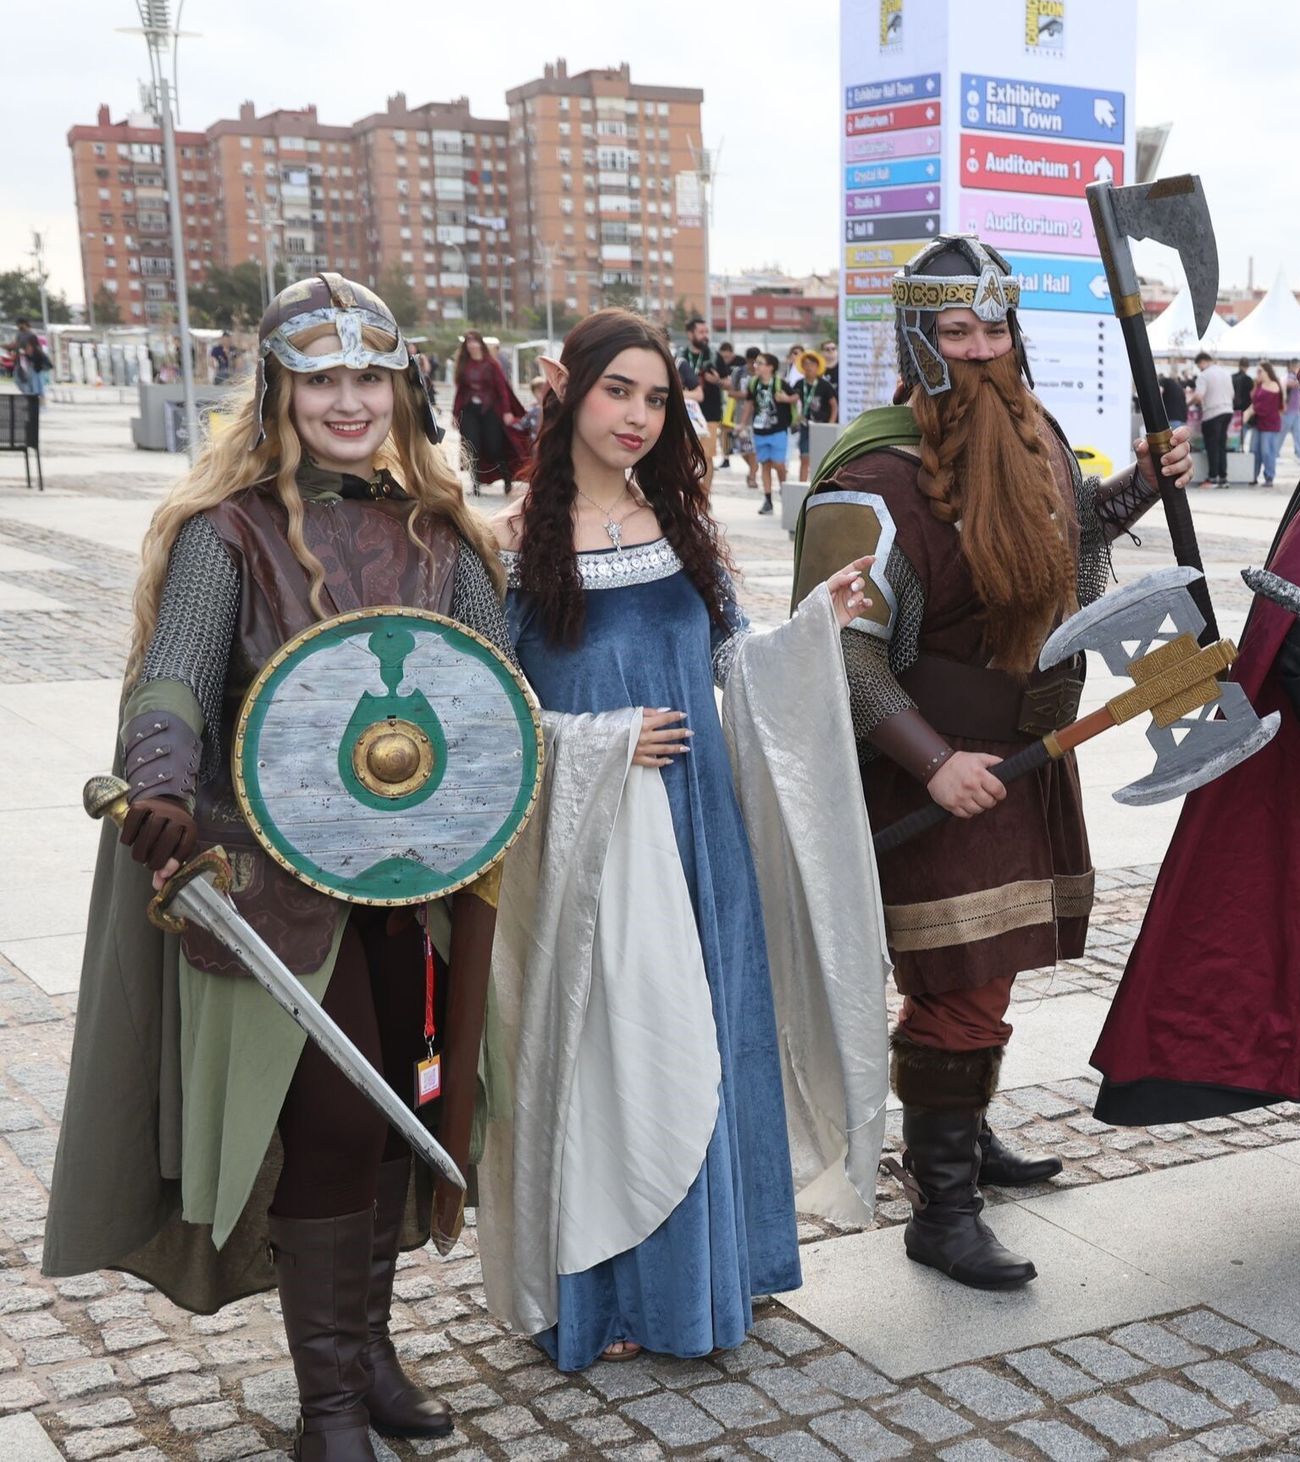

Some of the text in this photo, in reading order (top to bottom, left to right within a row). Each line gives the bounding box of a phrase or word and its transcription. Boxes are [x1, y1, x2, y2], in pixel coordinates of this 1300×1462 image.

[986, 81, 1060, 109] Exhibitor
[986, 103, 1017, 127] Hall
[1021, 108, 1062, 131] Town
[985, 151, 1069, 178] Auditorium
[1073, 160, 1081, 179] 1
[985, 212, 1069, 236] Auditorium
[1072, 219, 1081, 237] 2
[1043, 273, 1070, 293] Hall
